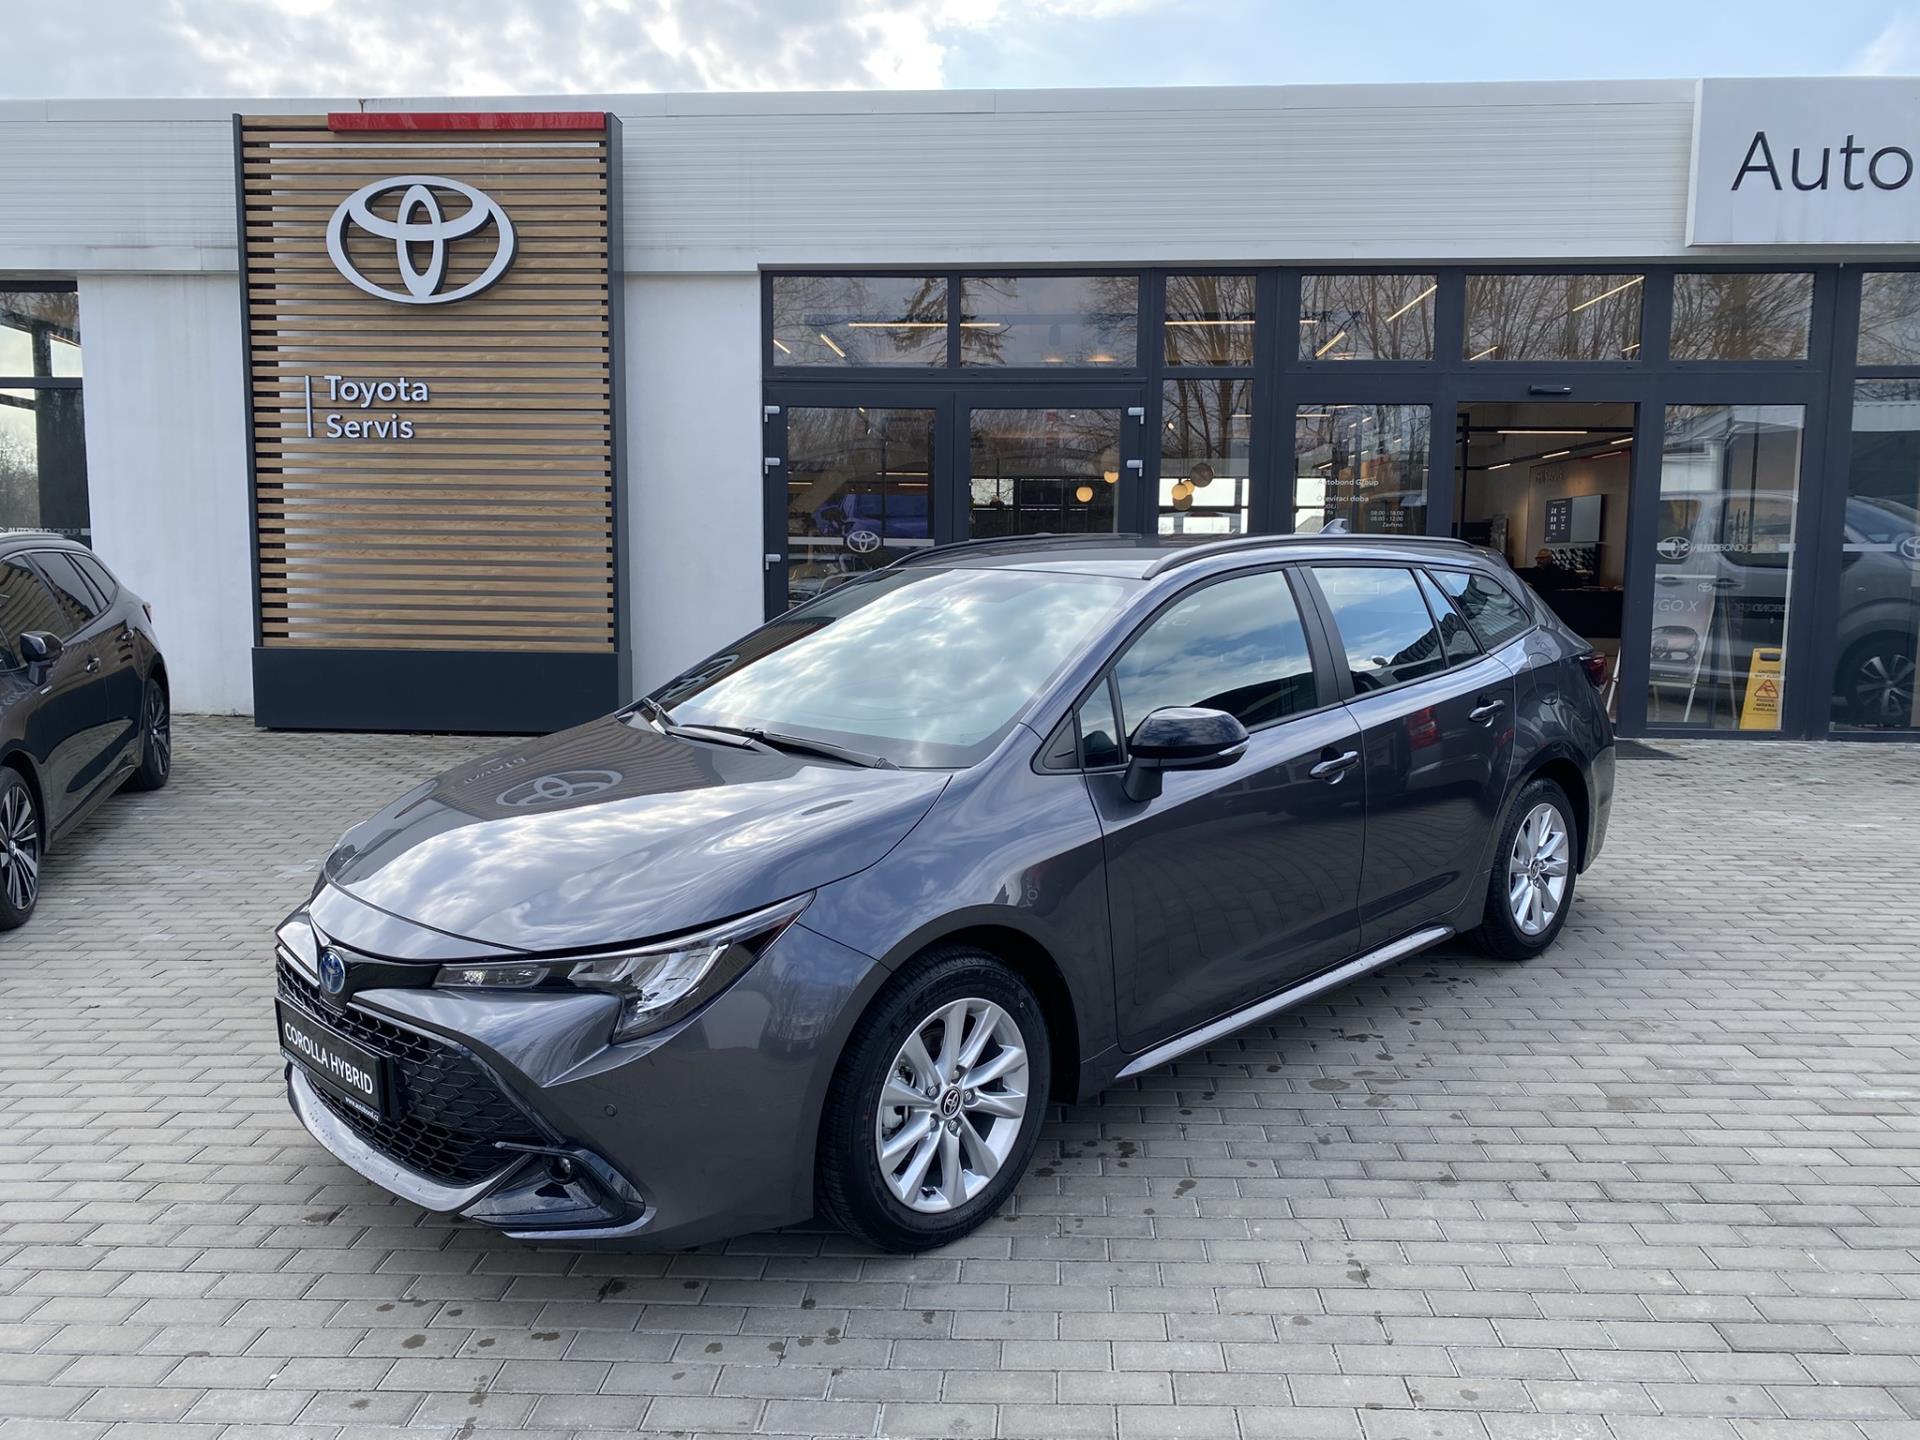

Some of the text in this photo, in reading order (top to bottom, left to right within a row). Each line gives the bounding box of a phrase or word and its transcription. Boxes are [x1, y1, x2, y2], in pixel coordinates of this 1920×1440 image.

[1731, 131, 1914, 191] Auto
[324, 375, 428, 408] Toyota
[326, 413, 414, 438] Servis
[284, 1022, 374, 1095] COROLLA HYBRID
